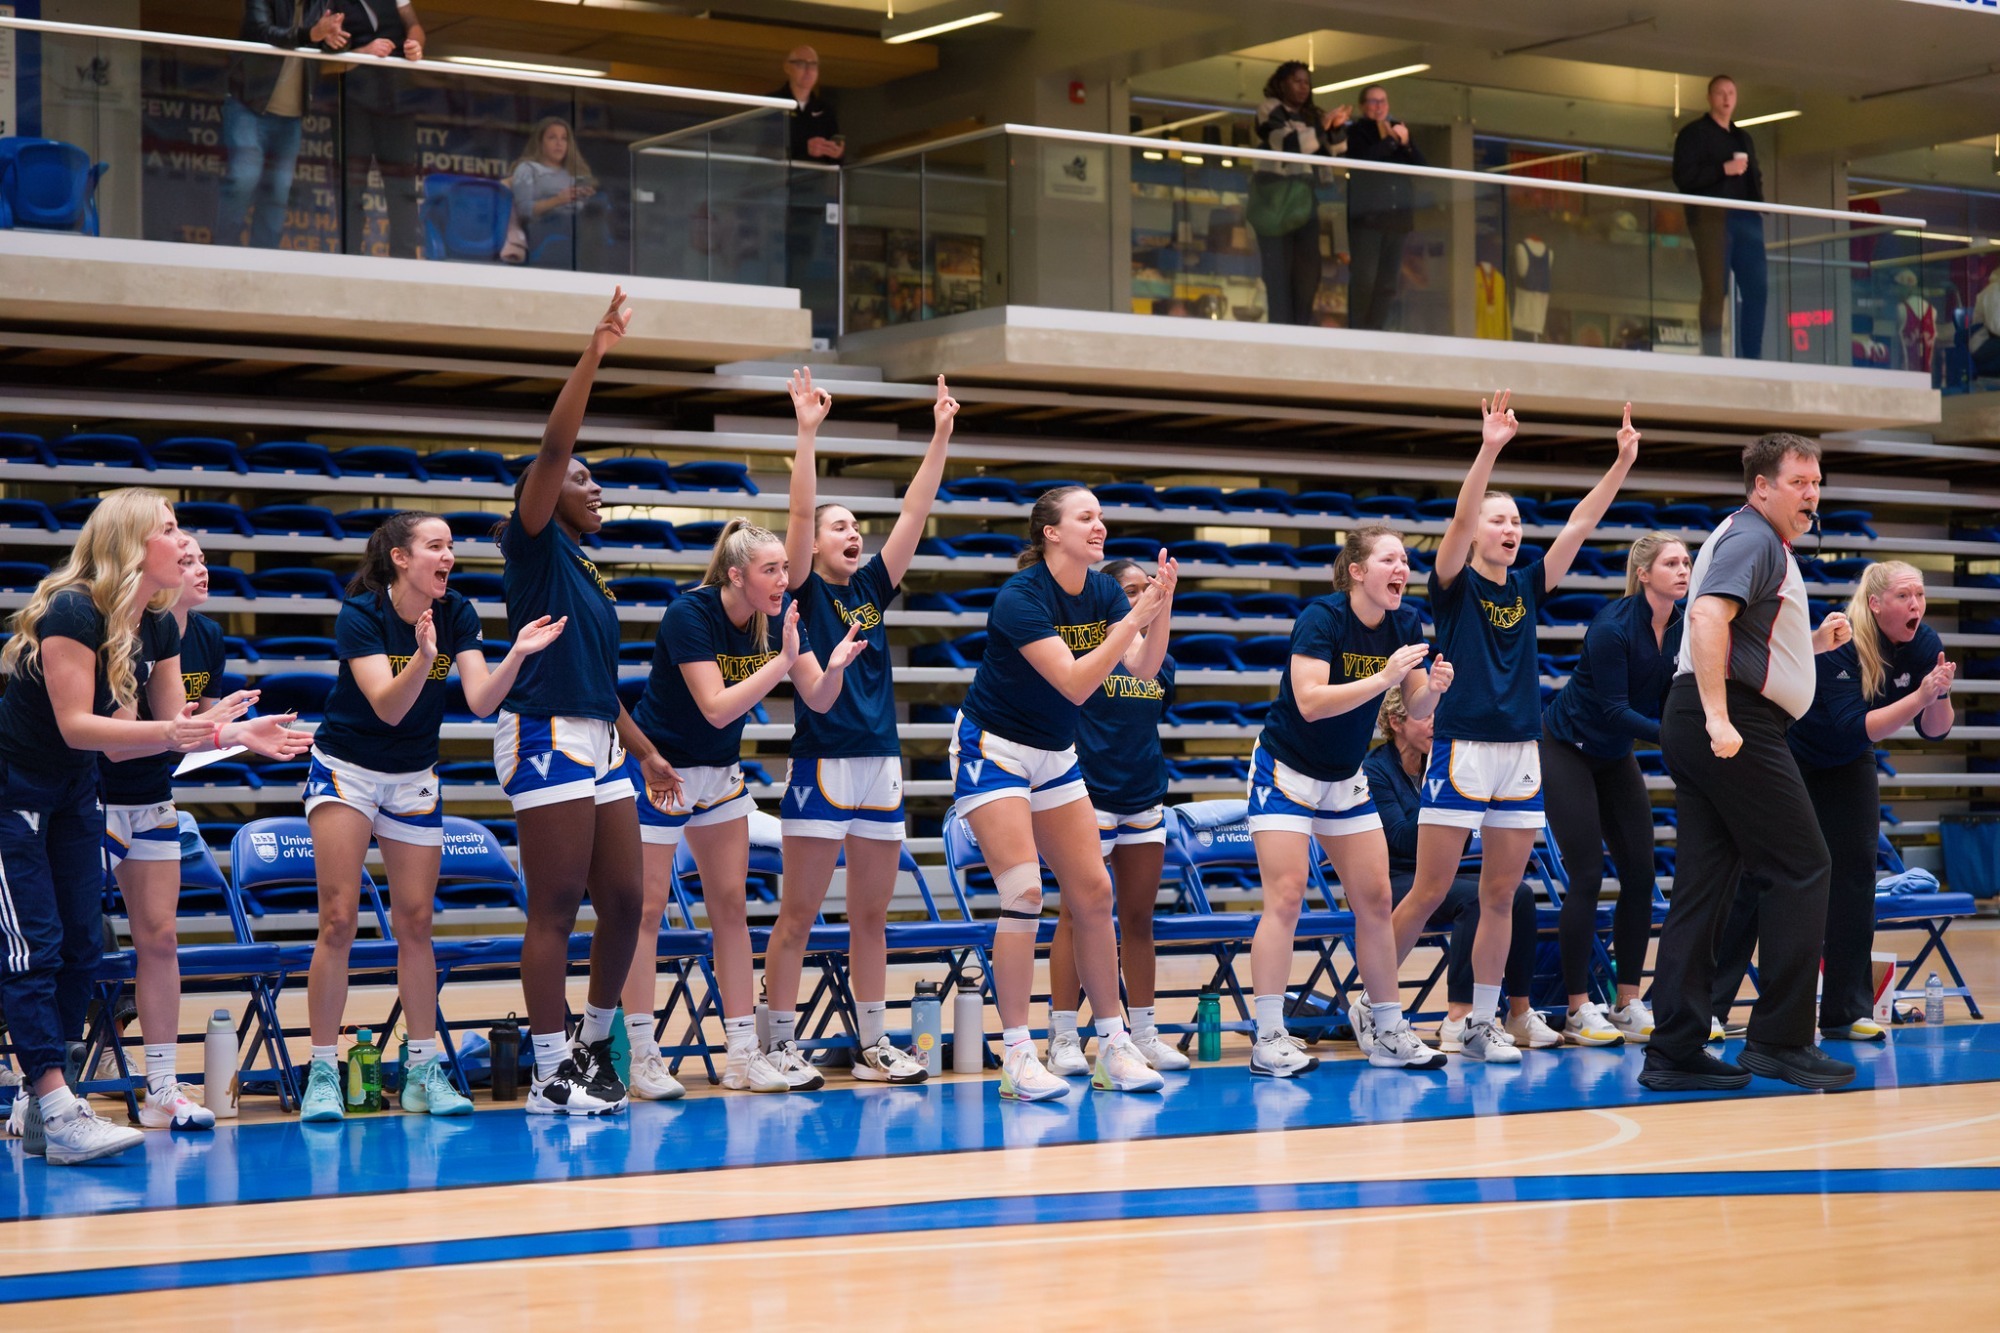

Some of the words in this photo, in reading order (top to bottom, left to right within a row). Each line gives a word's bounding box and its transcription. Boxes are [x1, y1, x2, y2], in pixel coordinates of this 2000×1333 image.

[188, 127, 218, 146] TO
[422, 151, 509, 175] POTENTI
[1343, 652, 1388, 678] VIKE
[442, 832, 485, 845] niversity
[1216, 833, 1226, 843] of
[283, 847, 294, 858] of
[447, 844, 489, 856] Victoria
